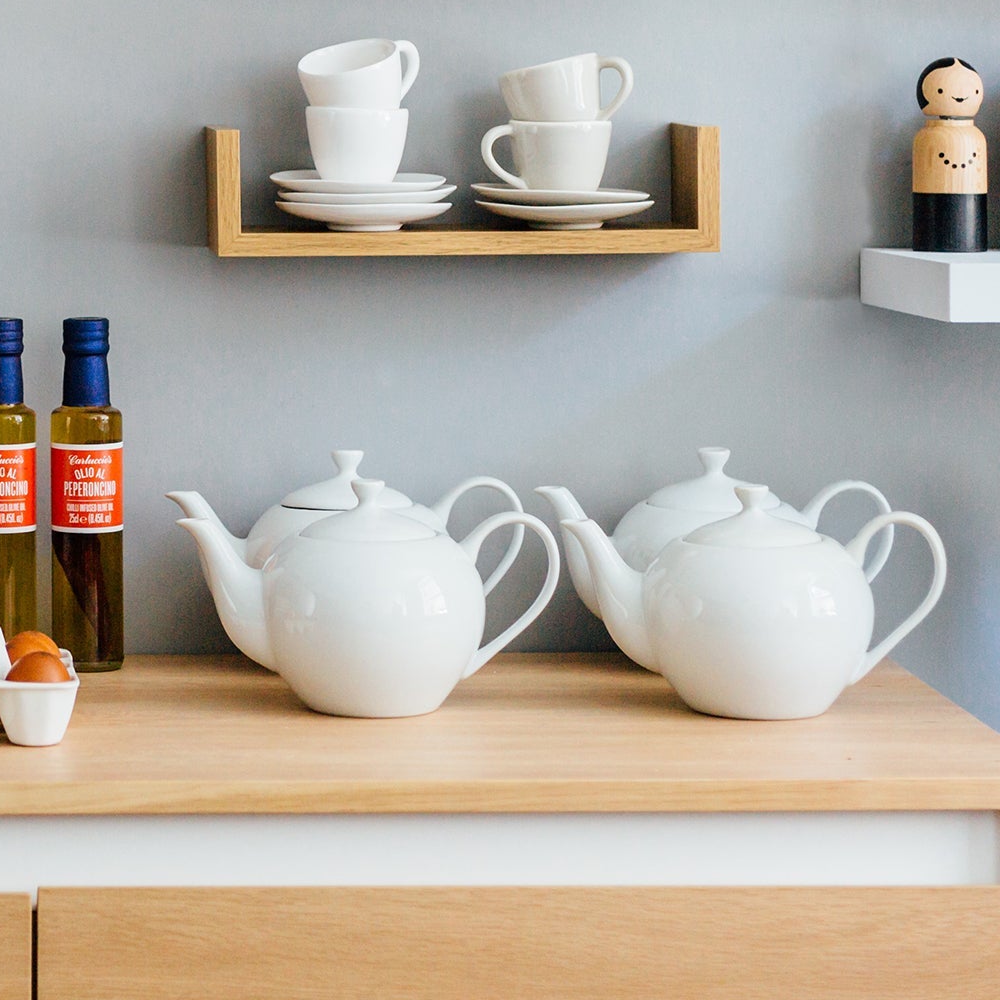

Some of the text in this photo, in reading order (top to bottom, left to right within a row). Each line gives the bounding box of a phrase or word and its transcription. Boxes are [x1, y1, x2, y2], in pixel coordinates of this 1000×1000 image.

[68, 455, 112, 465] Carluccio's
[7, 468, 16, 479] AL
[74, 467, 106, 479] OLIO AL
[64, 481, 116, 496] PEPERONCINO
